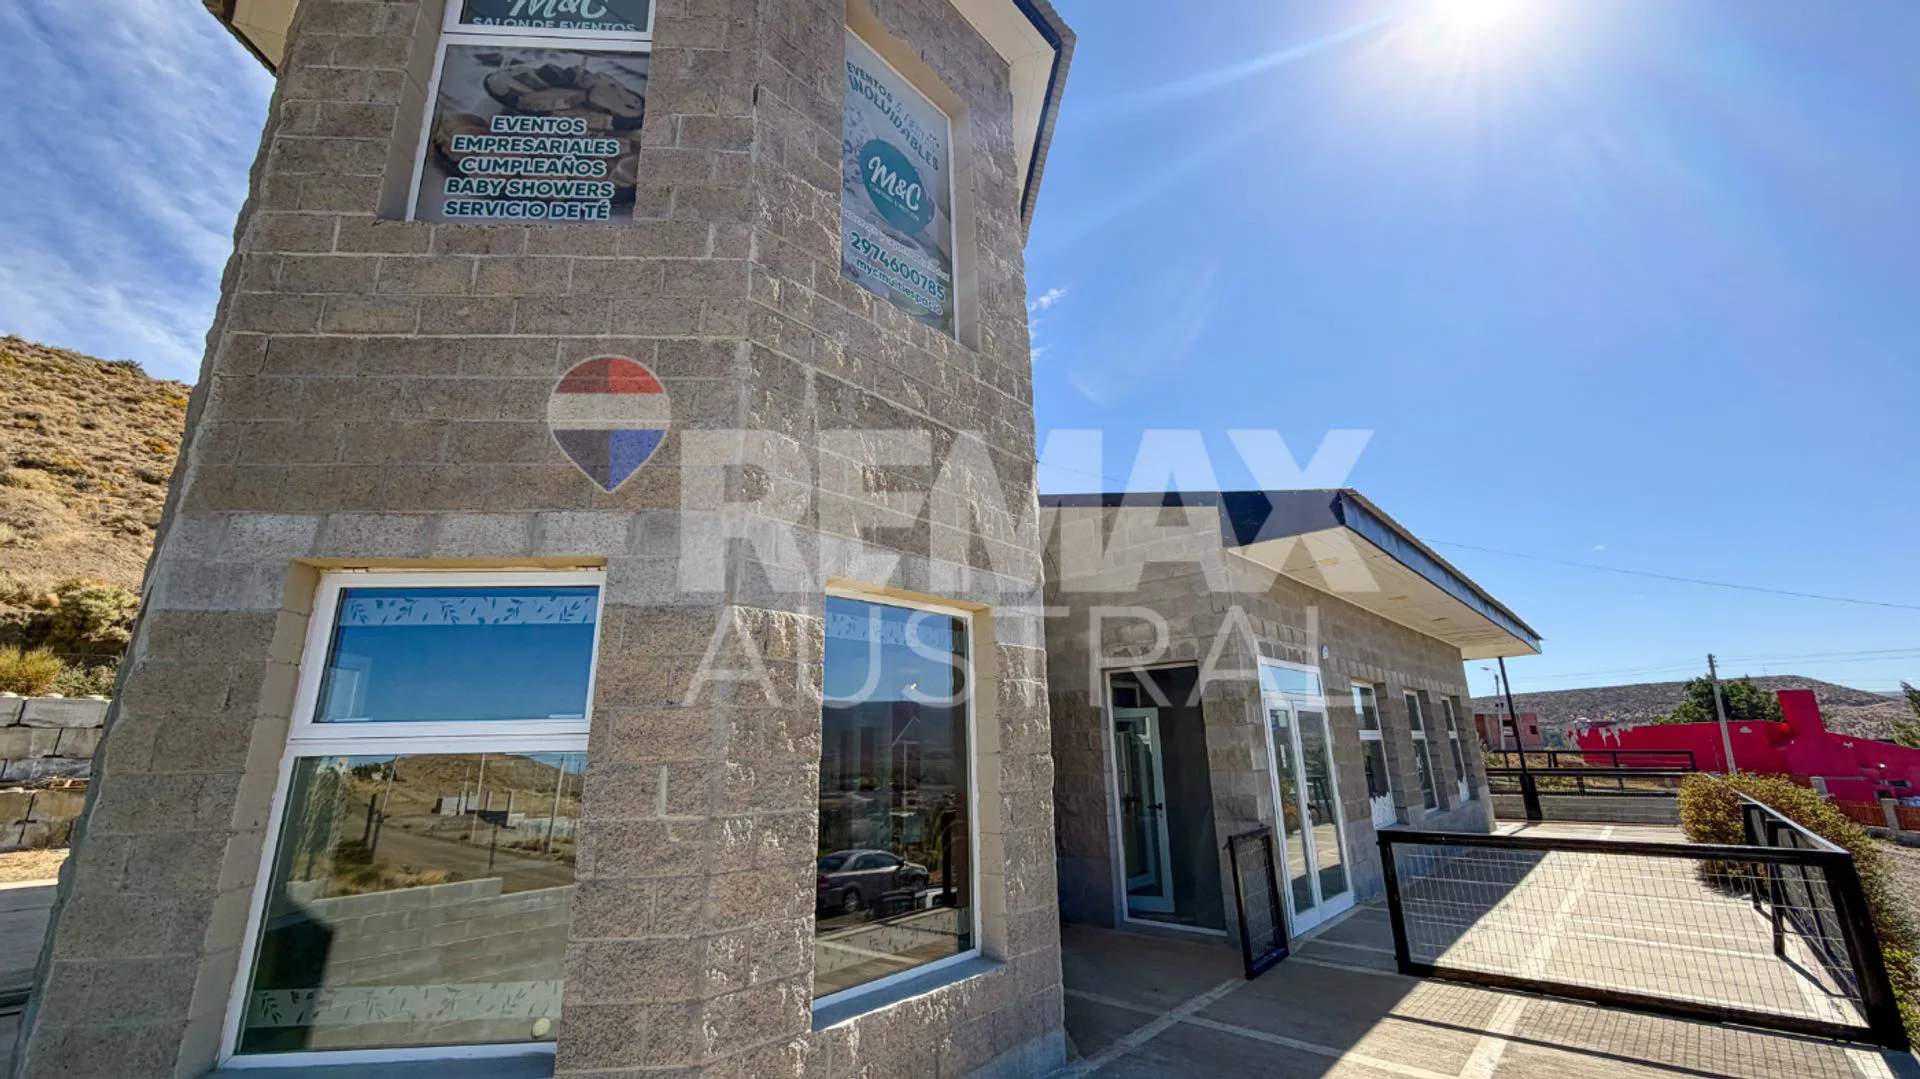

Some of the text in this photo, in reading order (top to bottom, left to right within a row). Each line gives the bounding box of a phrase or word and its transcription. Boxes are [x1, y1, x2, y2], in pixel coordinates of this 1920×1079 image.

[846, 60, 893, 103] EVENTOS
[492, 116, 587, 133] EVENTOS
[453, 136, 619, 155] EMPRESARIALES
[460, 156, 606, 176] CUMPLEAÑOS
[446, 179, 614, 198] BABY SHOWERS
[868, 156, 921, 211] M&C
[444, 201, 610, 220] SERVICIO DE TÉ
[850, 231, 946, 301] 2974600785
